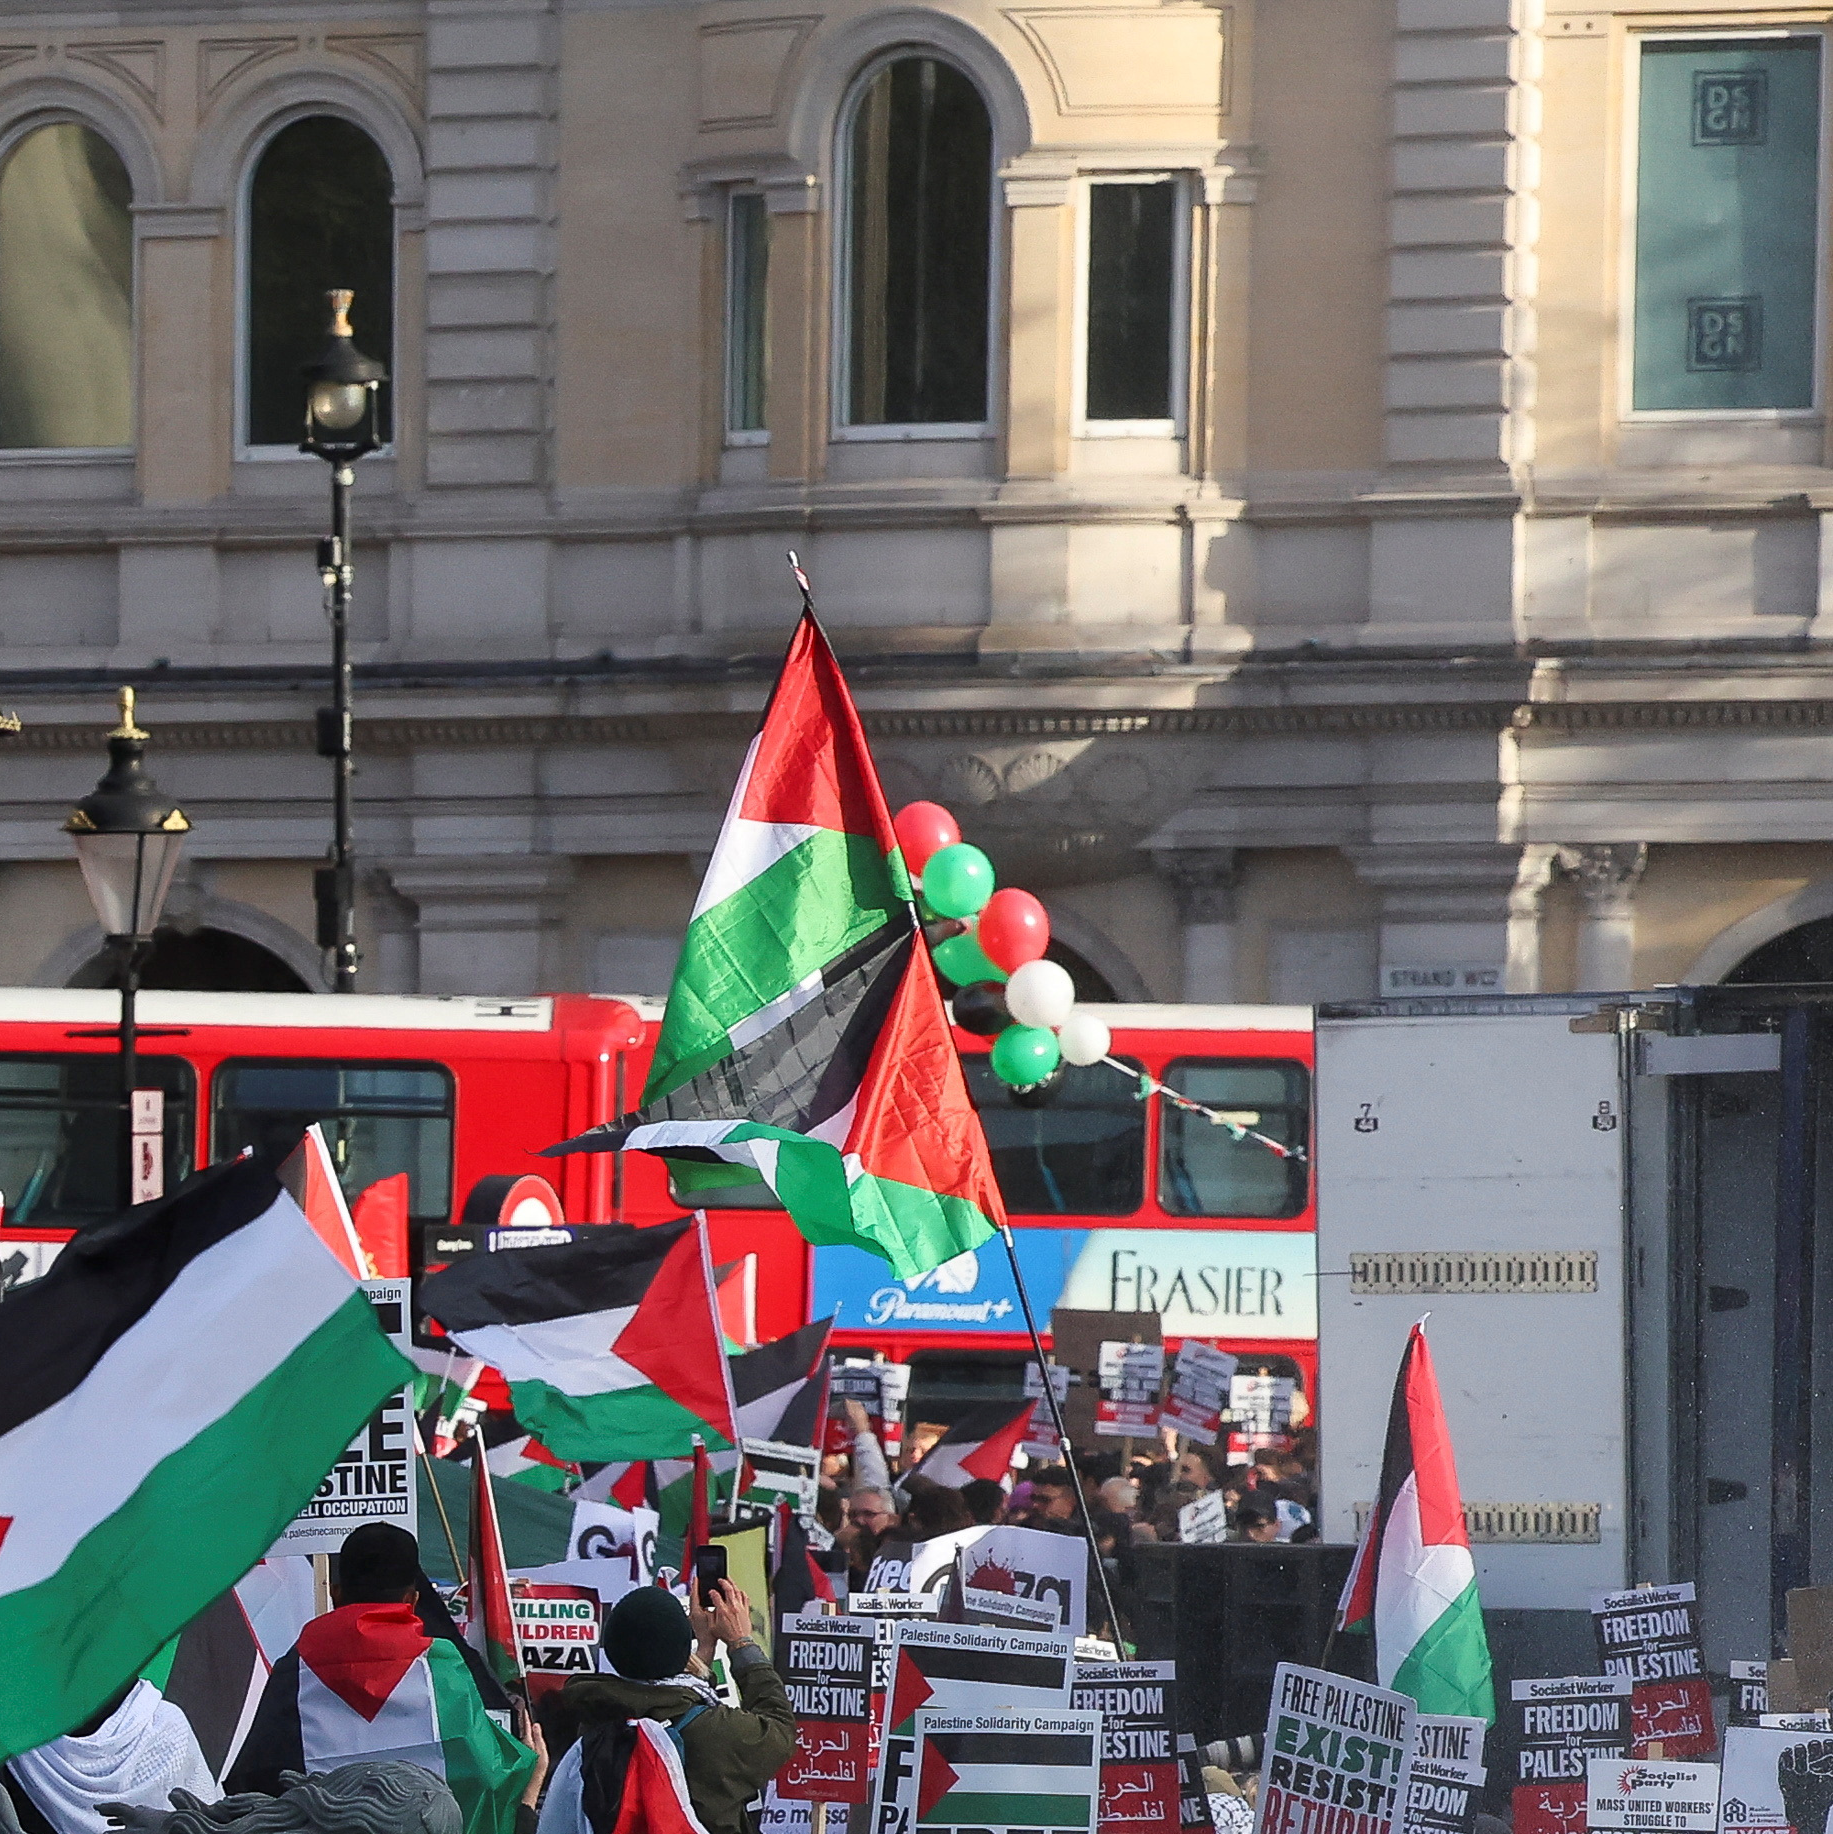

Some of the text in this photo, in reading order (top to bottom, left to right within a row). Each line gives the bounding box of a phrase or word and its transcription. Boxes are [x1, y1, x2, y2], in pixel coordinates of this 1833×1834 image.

[1389, 970, 1455, 988] STRAND
[1111, 1249, 1284, 1317] FRASIER
[321, 1499, 408, 1517] OCCUPATION
[888, 1598, 923, 1612] Worker
[1603, 1589, 1681, 1610] Socialist Worker
[795, 1619, 862, 1634] Socialist Worker
[1600, 1608, 1690, 1645] FREEDOM
[900, 1628, 1068, 1656] Palestine Solidarity Campaign
[524, 1646, 593, 1671] AZA
[789, 1641, 864, 1671] FREEDOM
[1604, 1649, 1701, 1683] PALESTINE
[1076, 1666, 1158, 1680] Socialist Worker
[785, 1686, 865, 1718] PALESTINE
[1073, 1687, 1164, 1714] FREEDOM
[1530, 1682, 1616, 1698] Socialist Worker
[1281, 1672, 1321, 1716] FREE
[1323, 1679, 1407, 1742] PALESTINE
[1524, 1703, 1620, 1735] FREEDOM
[923, 1715, 1094, 1734] Palestine Solidarity Campaign
[794, 1728, 850, 1757] الحرية
[1274, 1717, 1403, 1785] EXIST!
[787, 1759, 856, 1785] لفلسطين
[1636, 1768, 1698, 1781] Socialist
[1269, 1758, 1397, 1819] RESIST!
[1595, 1800, 1714, 1814] MASS UNITED WORKERS'
[1623, 1815, 1687, 1828] STRUGGLE TO
